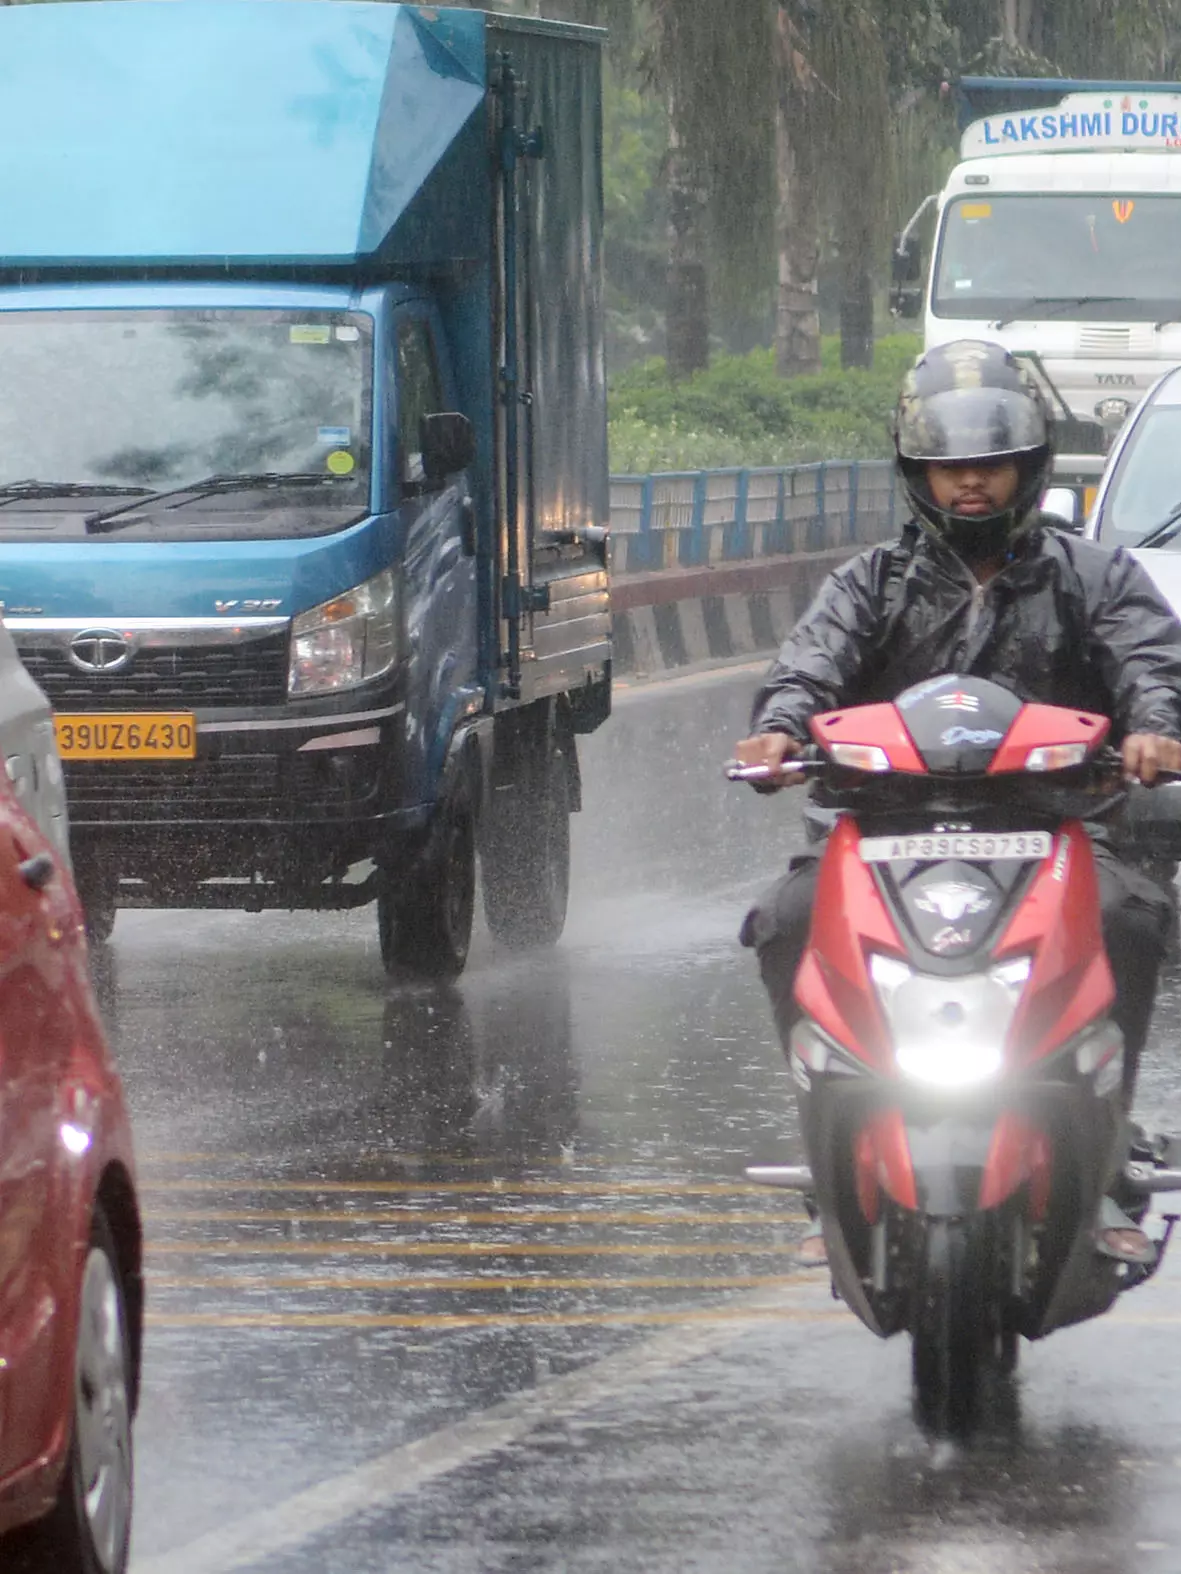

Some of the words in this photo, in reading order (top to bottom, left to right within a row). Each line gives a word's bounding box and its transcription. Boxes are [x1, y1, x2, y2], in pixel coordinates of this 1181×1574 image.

[983, 112, 1112, 145] LAKSHMI
[1095, 373, 1137, 386] TATA
[54, 723, 191, 750] 39UZ6430
